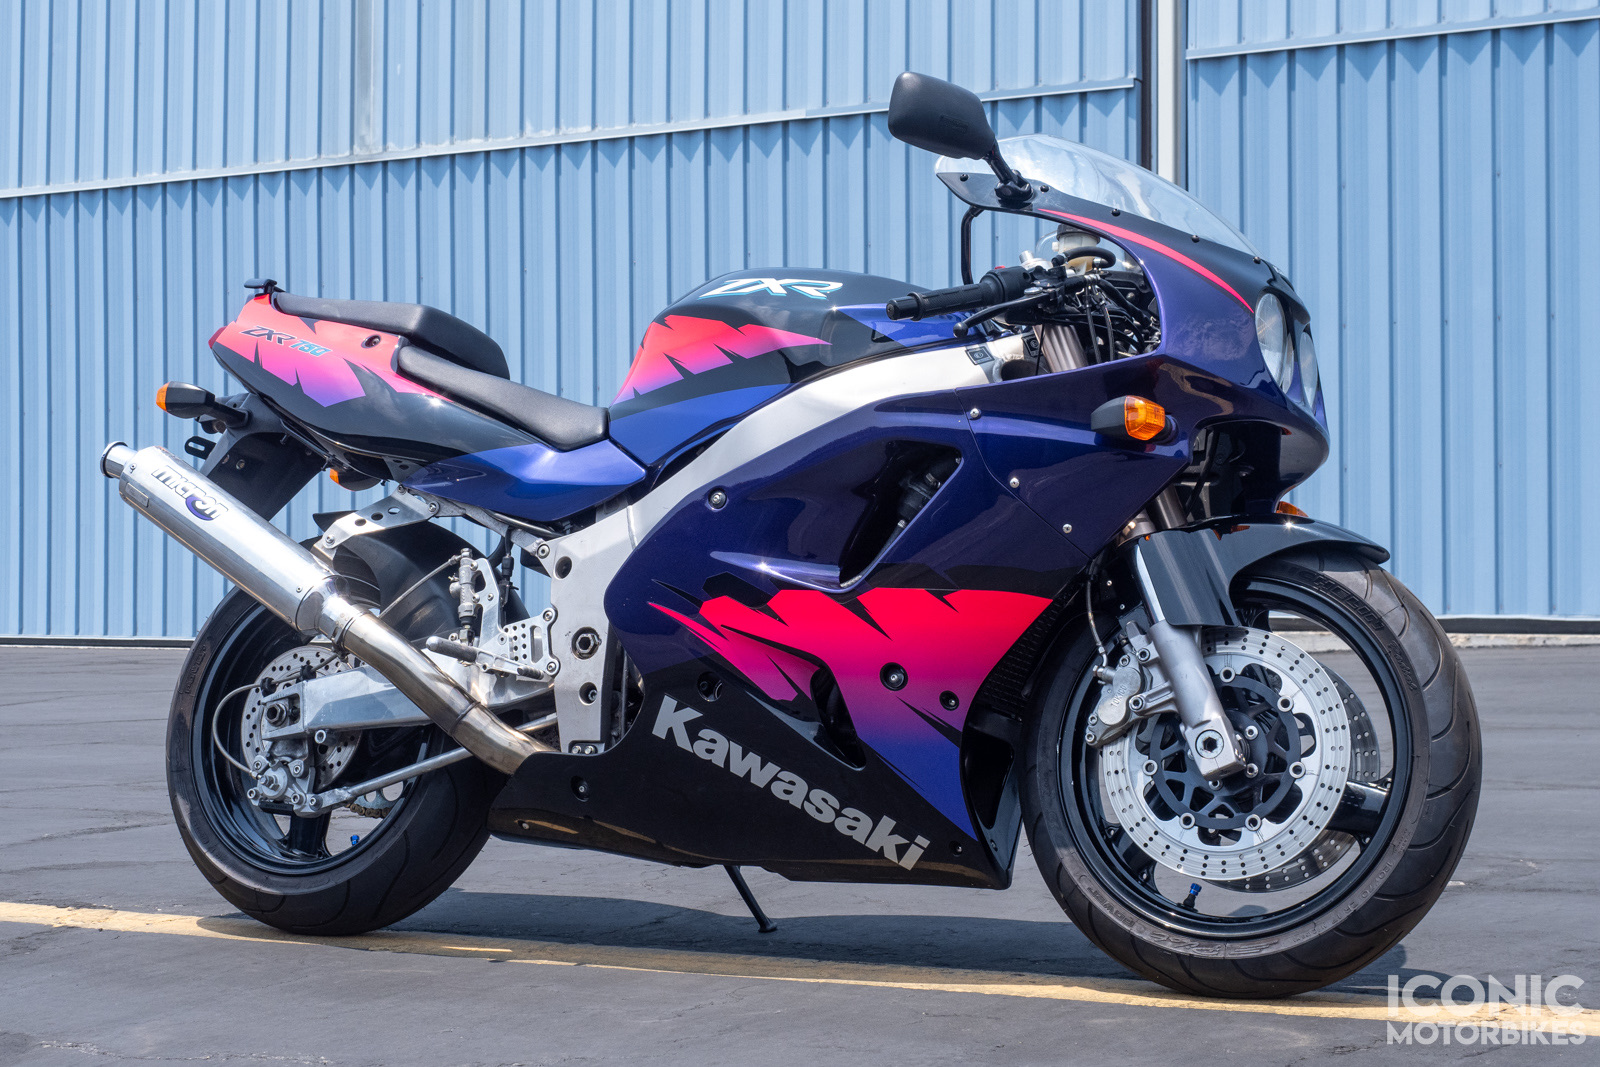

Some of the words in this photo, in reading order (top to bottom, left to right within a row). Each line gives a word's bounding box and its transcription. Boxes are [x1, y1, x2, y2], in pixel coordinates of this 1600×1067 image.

[697, 278, 843, 300] ZXR
[289, 339, 333, 357] 750
[1110, 684, 1128, 708] TOKICO
[652, 693, 931, 871] Kawasaki
